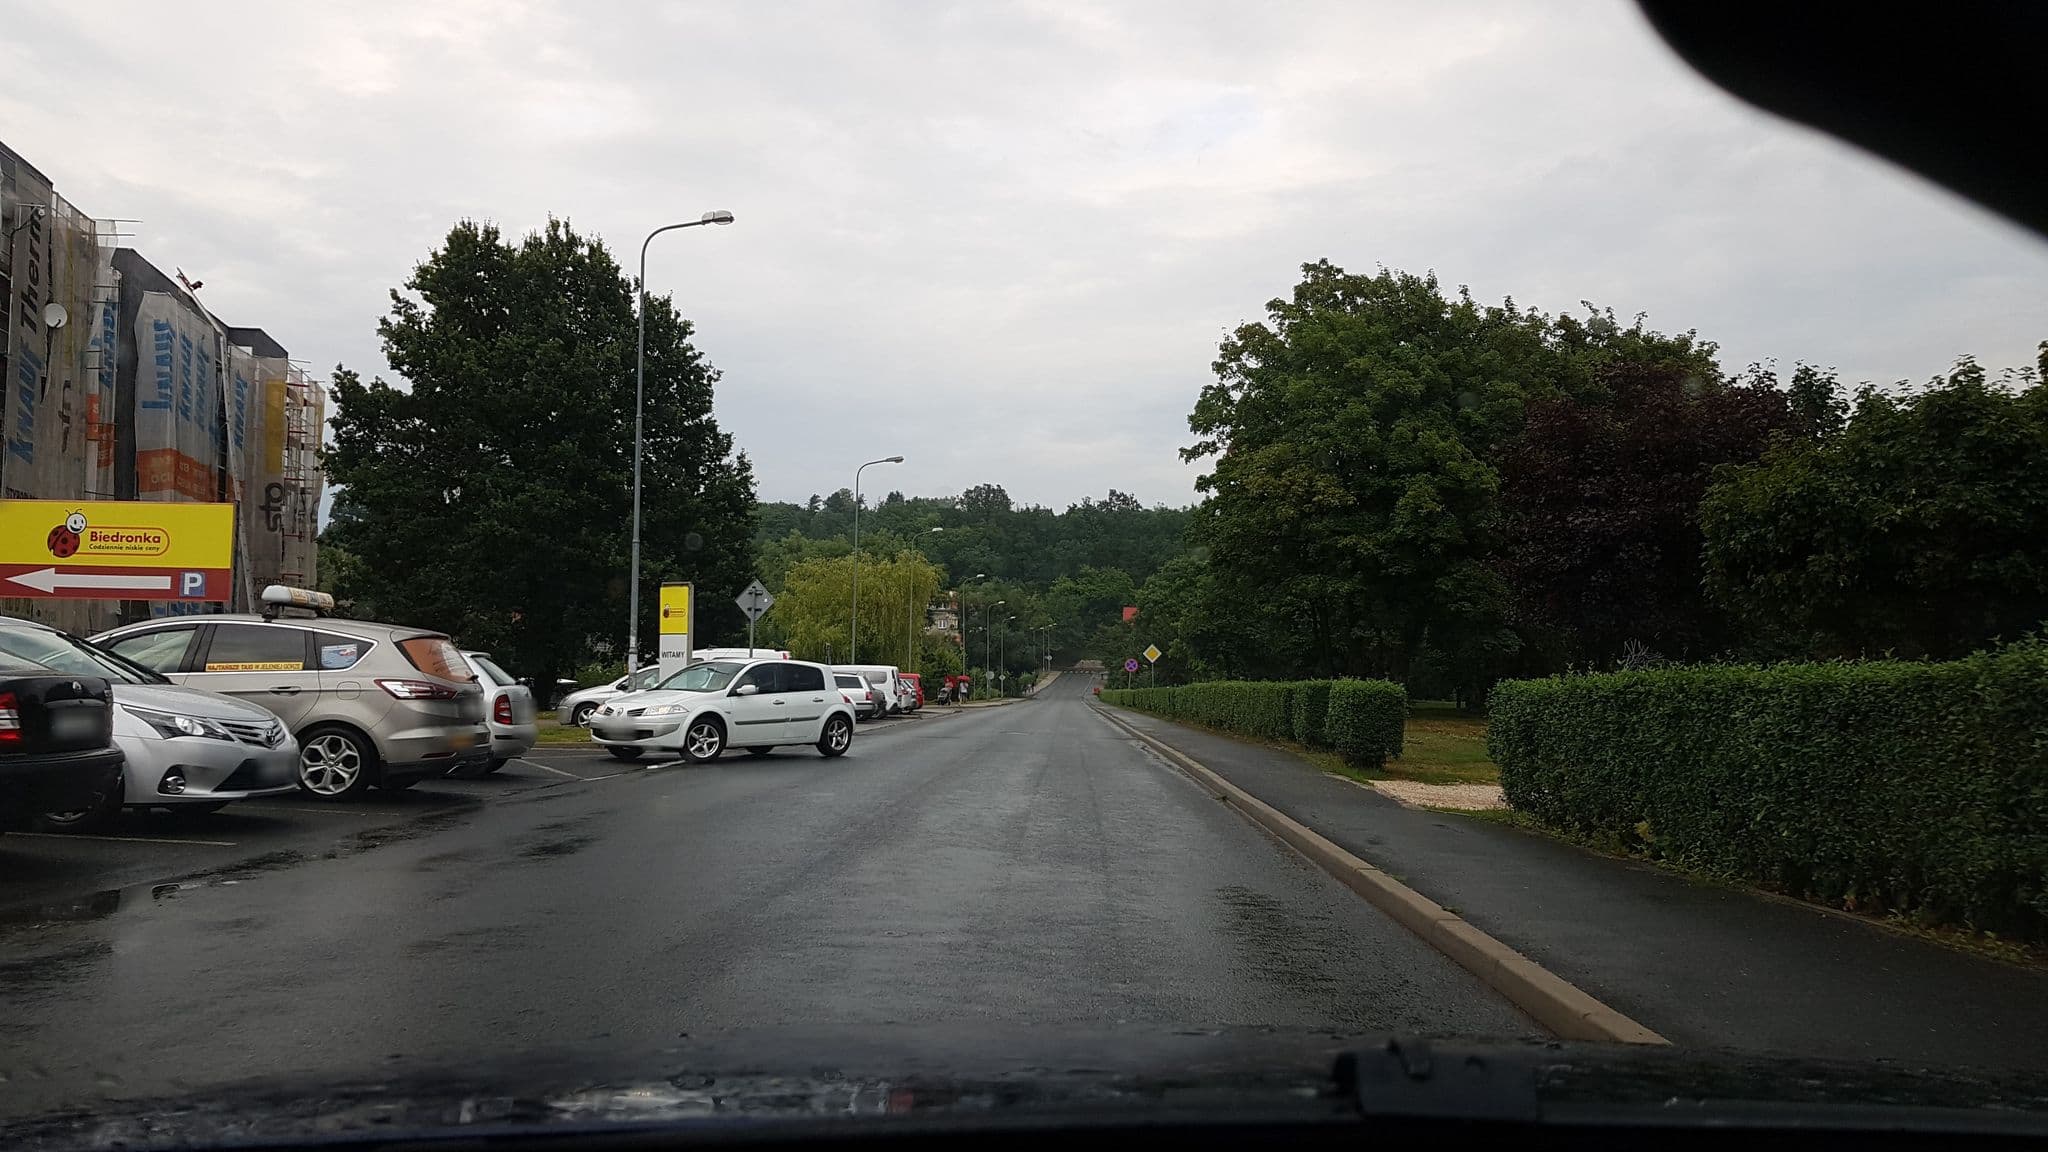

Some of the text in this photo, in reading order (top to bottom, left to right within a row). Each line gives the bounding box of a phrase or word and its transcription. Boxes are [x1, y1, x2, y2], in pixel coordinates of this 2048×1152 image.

[90, 531, 161, 544] Biedronka
[88, 543, 123, 551] Codziennie
[184, 572, 203, 595] P
